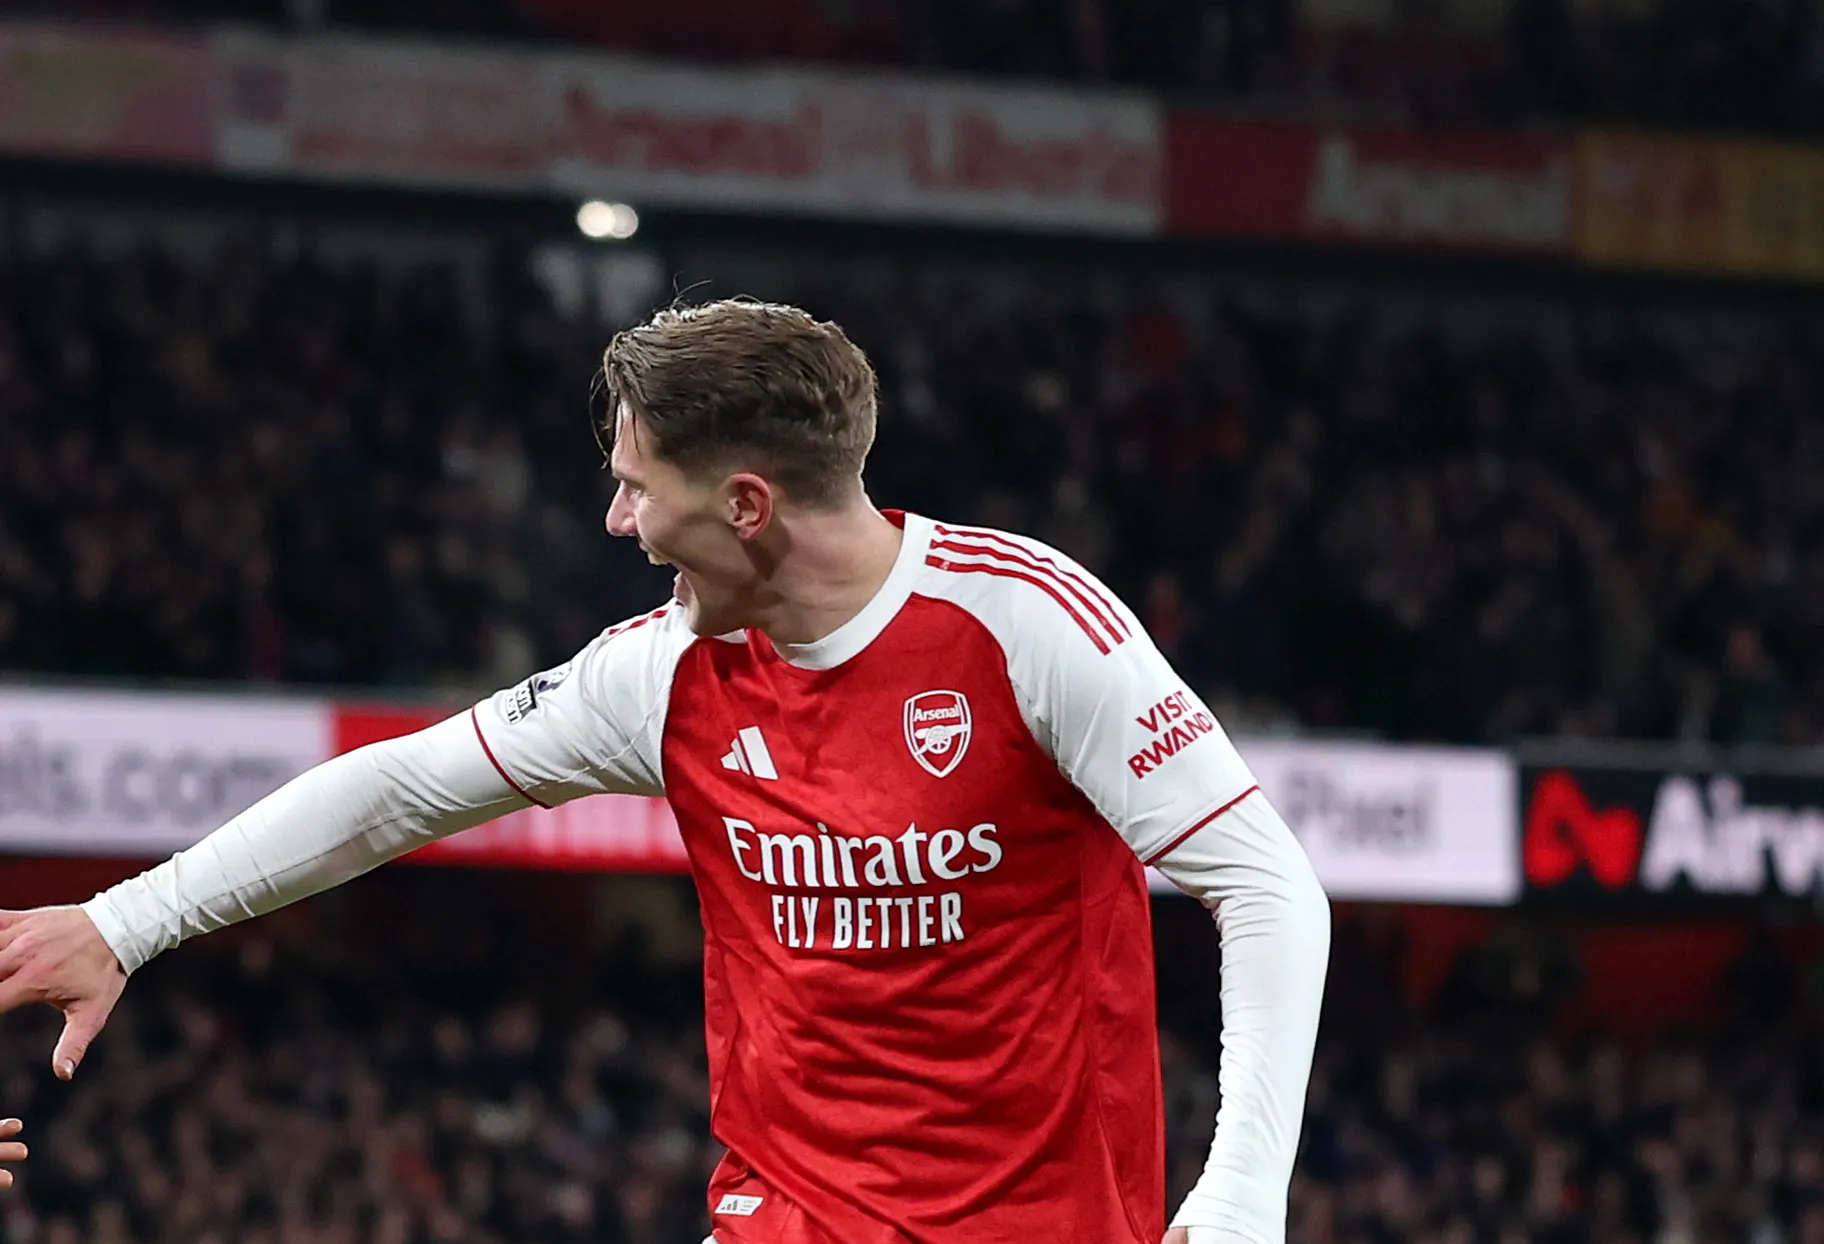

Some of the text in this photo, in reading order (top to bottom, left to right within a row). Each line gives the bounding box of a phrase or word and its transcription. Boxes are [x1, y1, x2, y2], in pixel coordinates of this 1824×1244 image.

[913, 704, 961, 722] Arsenal
[1135, 690, 1193, 733] VISIT
[1127, 711, 1215, 780] RWAND
[721, 815, 1003, 888] Emirates
[771, 892, 965, 949] FLY BETTER
